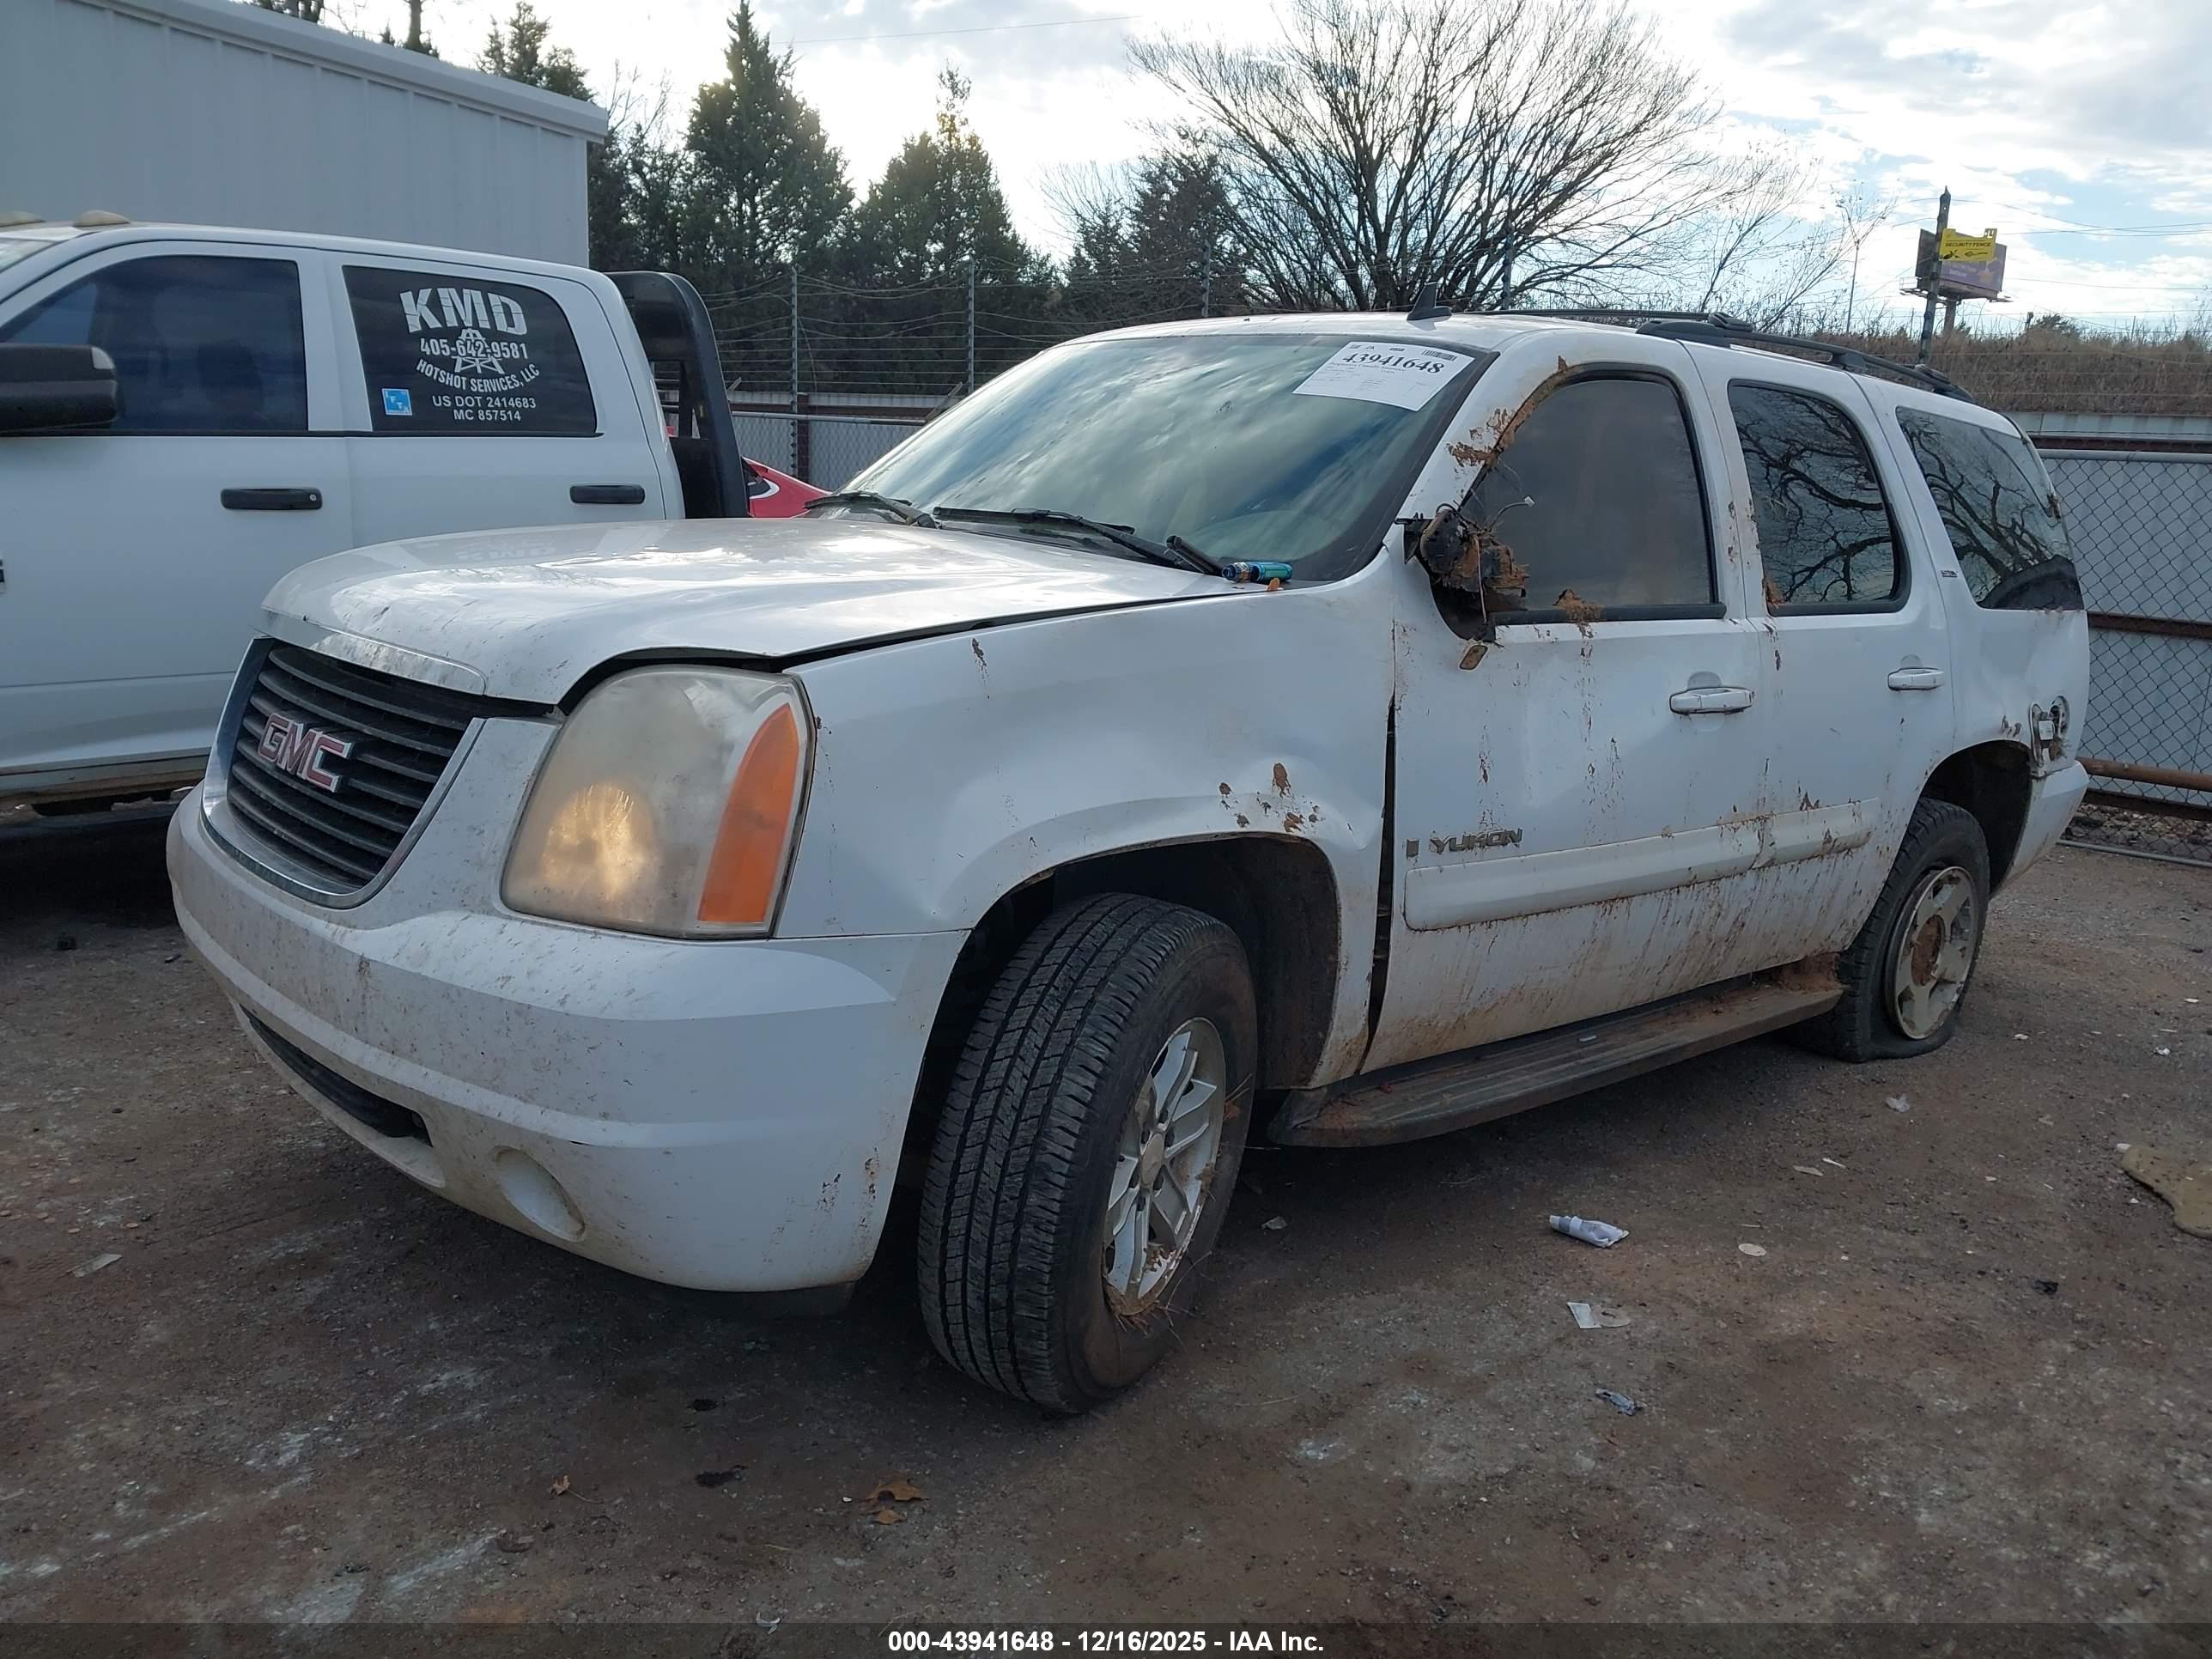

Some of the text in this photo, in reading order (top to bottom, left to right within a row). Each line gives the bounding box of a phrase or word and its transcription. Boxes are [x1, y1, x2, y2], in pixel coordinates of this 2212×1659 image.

[399, 288, 527, 334] KMD
[420, 337, 528, 359] 405-642-9581
[1342, 352, 1444, 374] 43941648
[416, 359, 540, 393] HOTSHOT SERVICES, LLC
[432, 395, 537, 409] US DOT 2414683
[453, 410, 522, 422] MC 857514
[258, 713, 353, 793] GMC
[1430, 828, 1523, 854] YUKON
